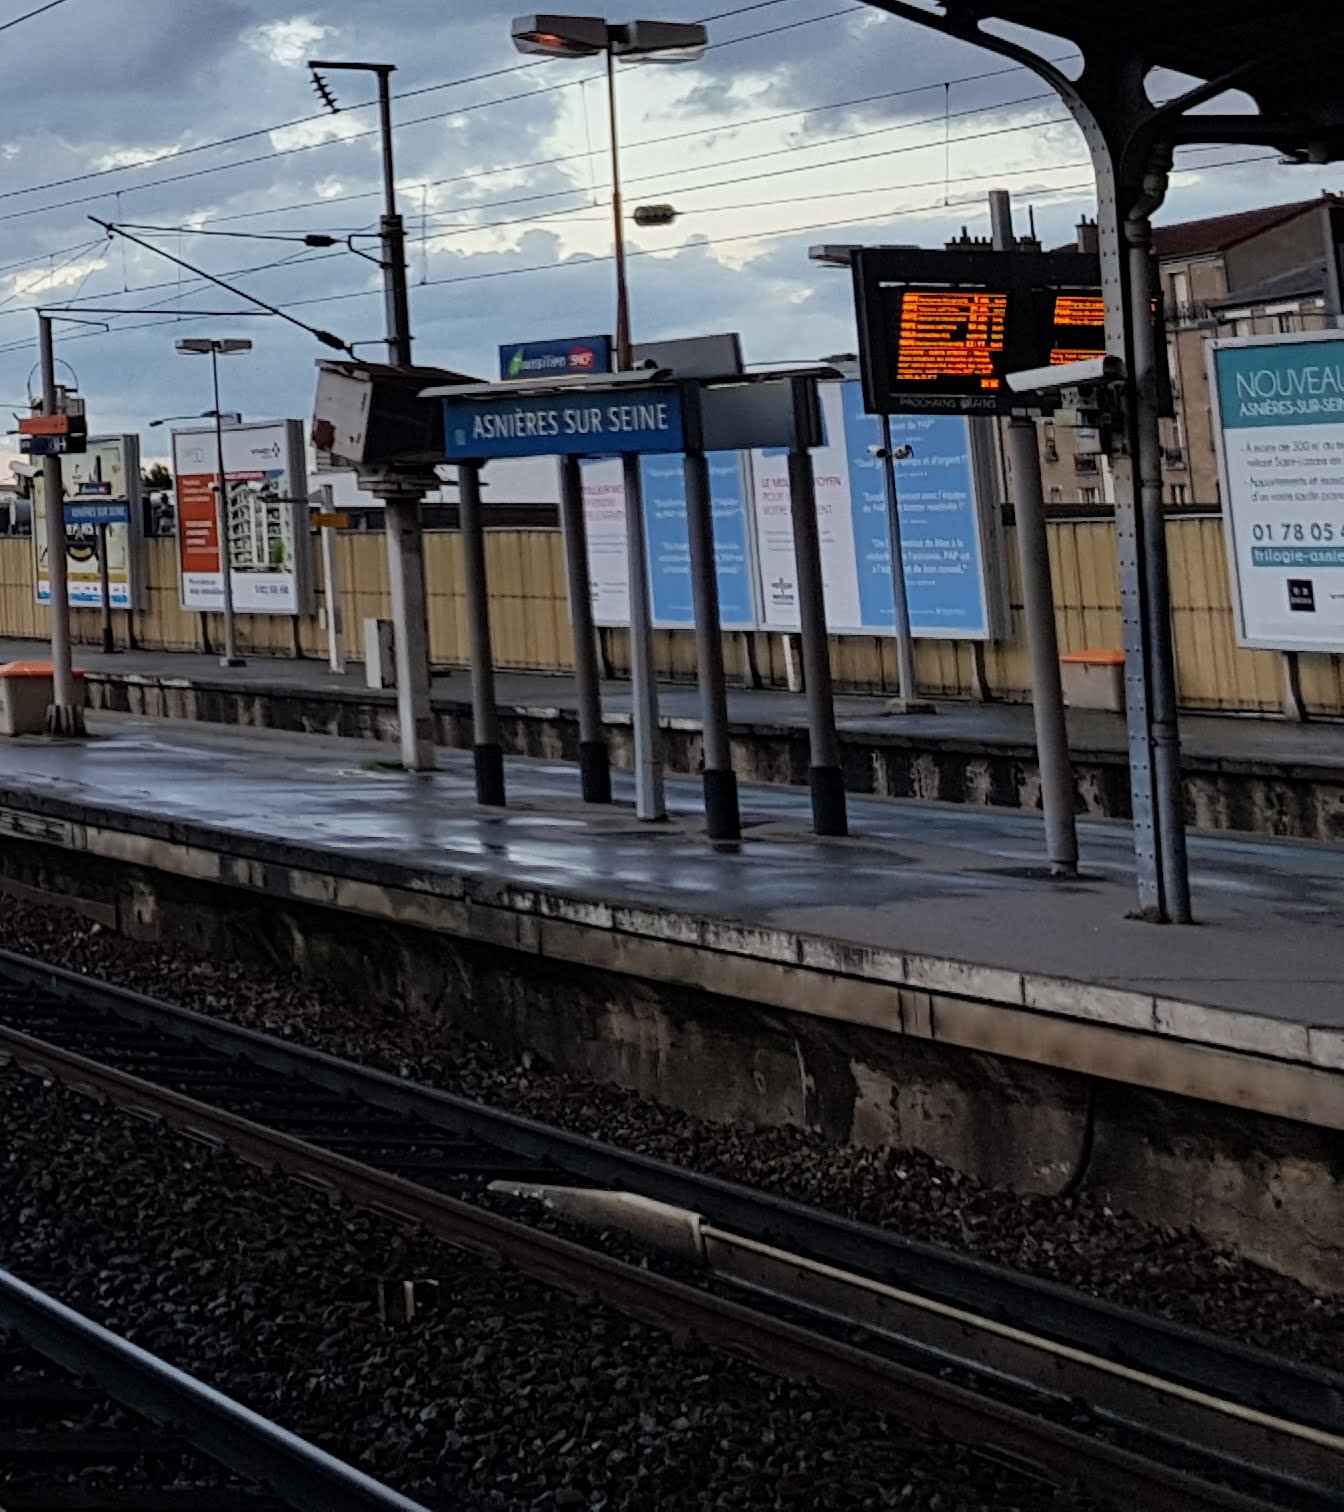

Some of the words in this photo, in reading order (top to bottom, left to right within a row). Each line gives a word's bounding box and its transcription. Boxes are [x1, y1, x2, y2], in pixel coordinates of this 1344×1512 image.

[472, 408, 560, 439] ASNIÈRES
[564, 407, 603, 435] SUR
[608, 403, 670, 432] SEINE
[1252, 523, 1273, 541] 01
[1281, 522, 1304, 541] 78
[1310, 522, 1334, 541] 05
